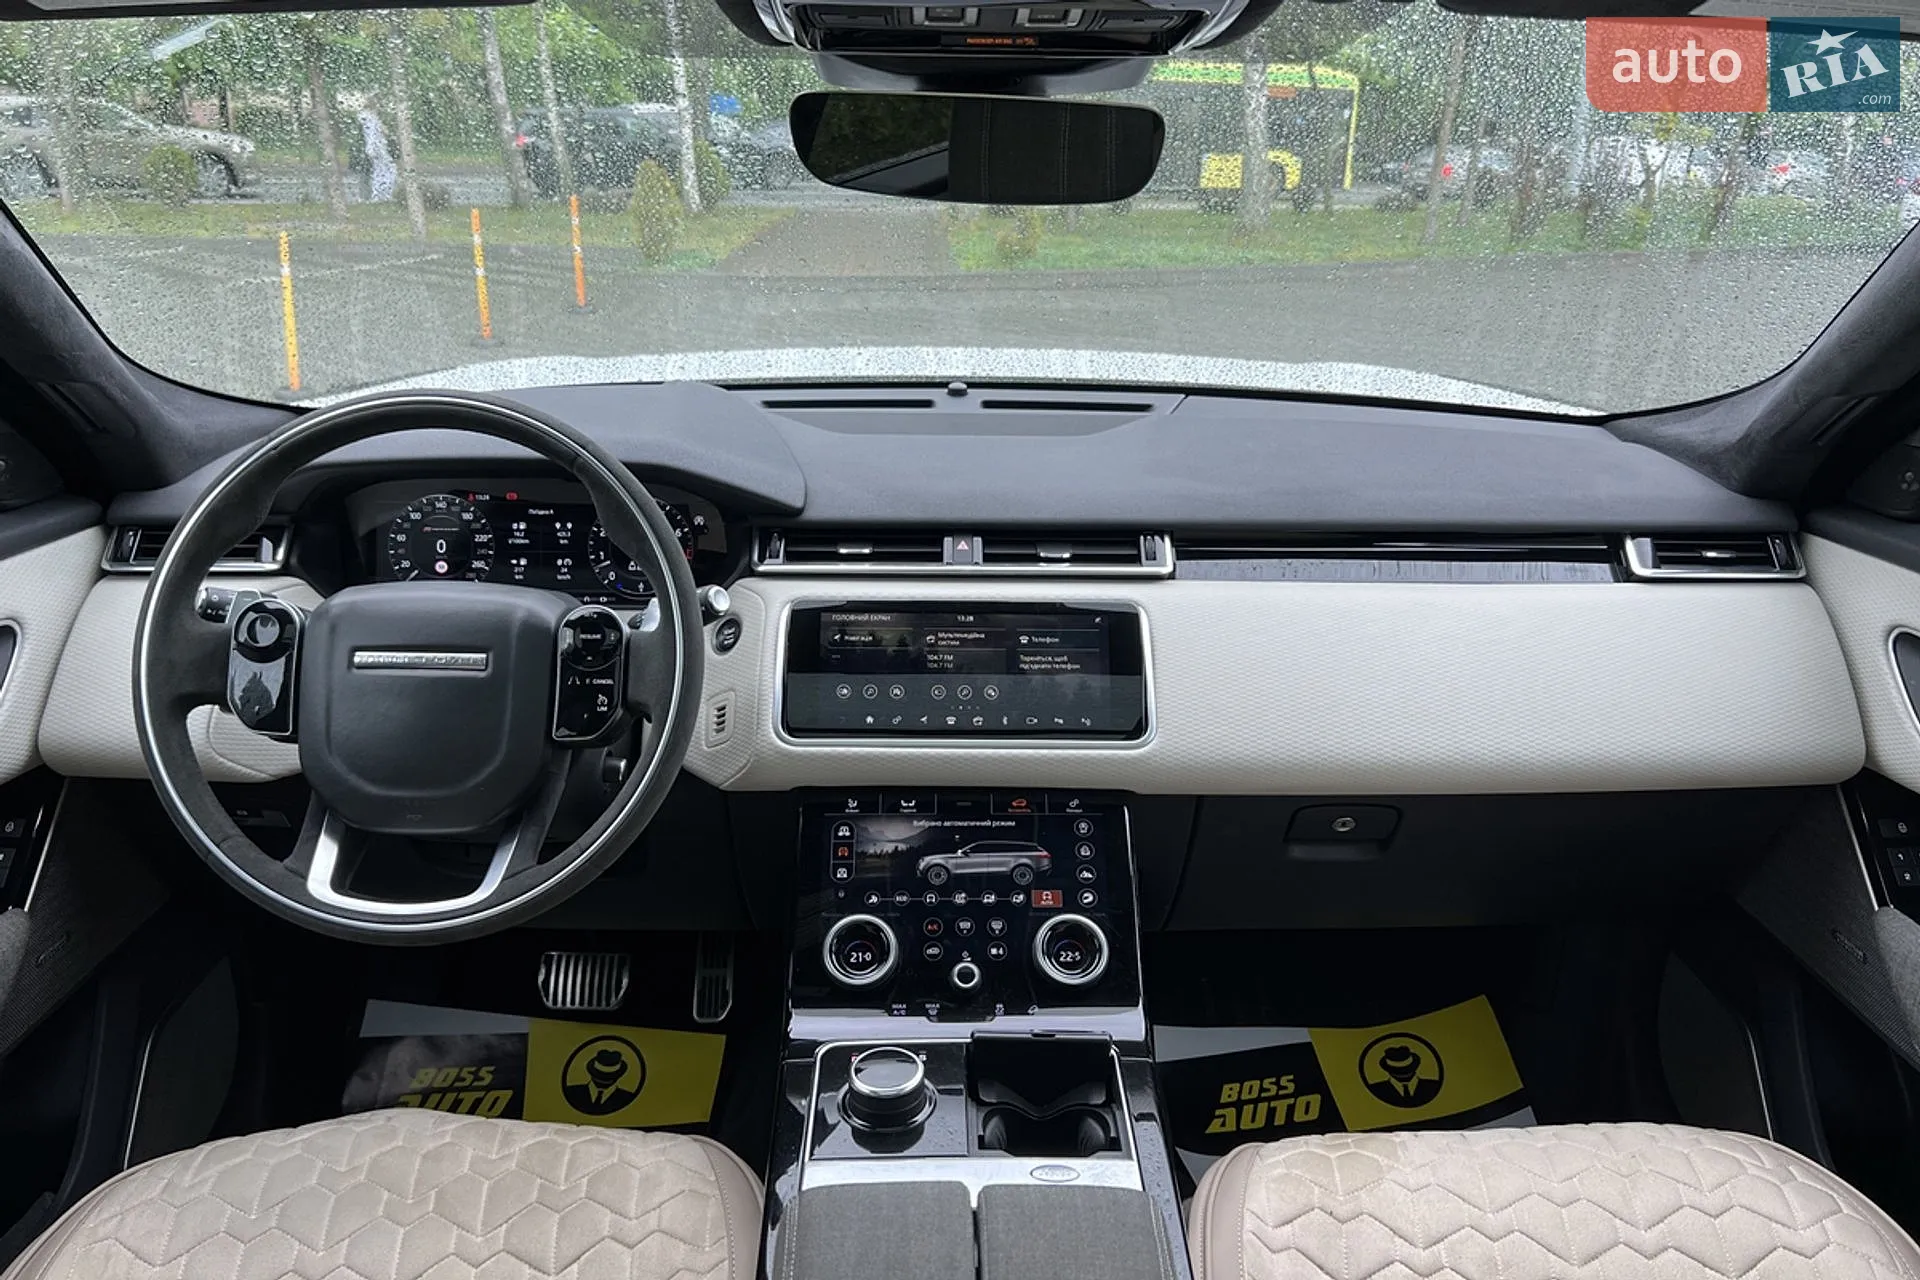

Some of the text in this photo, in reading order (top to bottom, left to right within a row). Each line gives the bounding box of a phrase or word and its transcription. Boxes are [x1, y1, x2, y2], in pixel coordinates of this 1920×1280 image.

[409, 512, 421, 520] 100
[675, 528, 682, 537] 6
[396, 534, 406, 542] 60
[474, 534, 487, 542] 220
[436, 539, 447, 553] 0
[599, 551, 605, 560] 1
[400, 560, 411, 568] 20
[471, 560, 486, 568] 260
[608, 571, 616, 581] 0
[831, 613, 869, 621] ГОЛОВНИЙ
[1031, 635, 1060, 644] Телефон
[943, 819, 991, 828] автоматичний
[409, 1065, 496, 1089] BOSS
[1220, 1074, 1296, 1104] BOSS
[1204, 1093, 1322, 1134] AUTO
